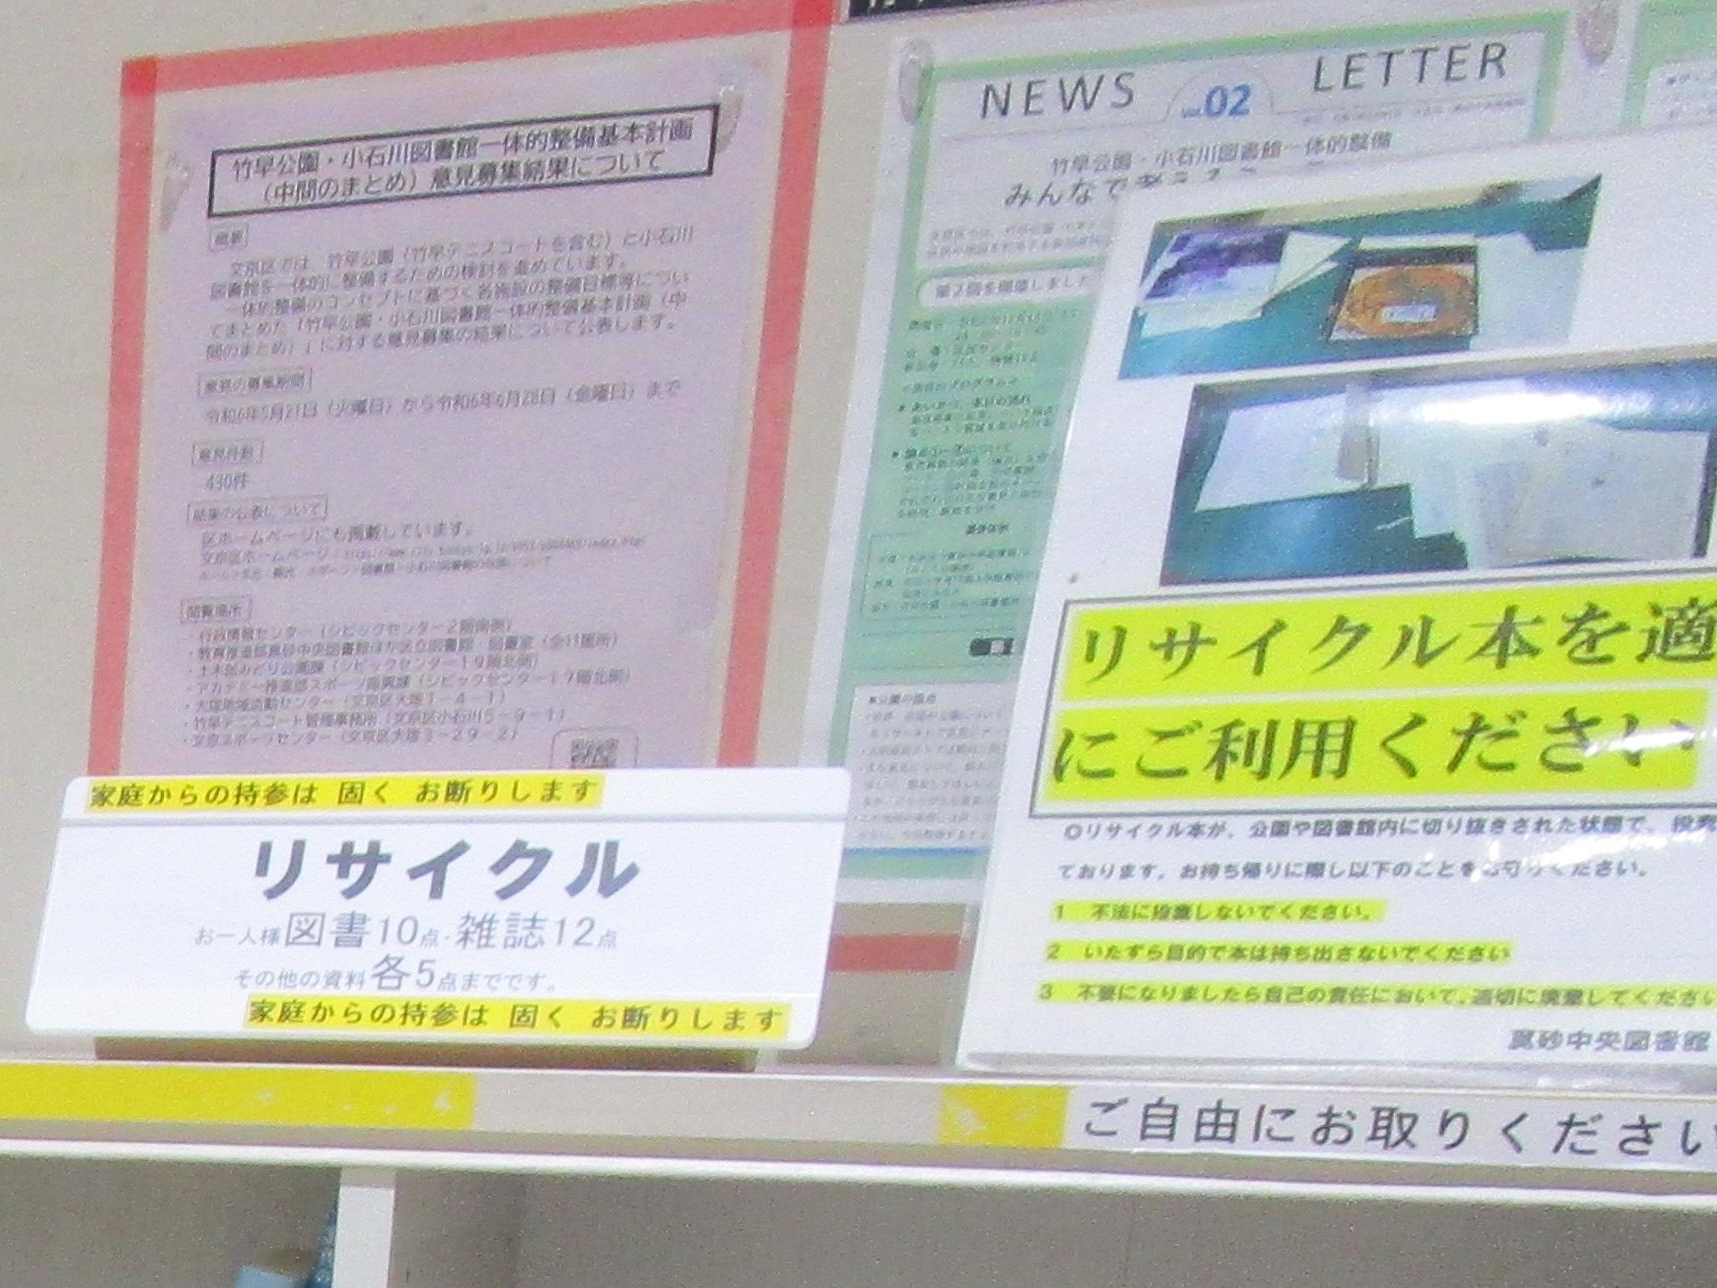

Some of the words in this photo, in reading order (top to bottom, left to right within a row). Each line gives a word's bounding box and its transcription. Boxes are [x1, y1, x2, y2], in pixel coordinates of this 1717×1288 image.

[980, 72, 1136, 119] NEWS
[1312, 42, 1508, 94] LETTER
[90, 781, 318, 808] 家庭からの持参は
[338, 779, 390, 807] 固く
[416, 777, 598, 804] お断りします
[255, 839, 641, 900] リサイクル
[249, 998, 488, 1028] 家庭からの持参は
[509, 1003, 563, 1029] 固く
[592, 1004, 784, 1032] お断りします
[1083, 1098, 1717, 1157] ご自由にお取りください
